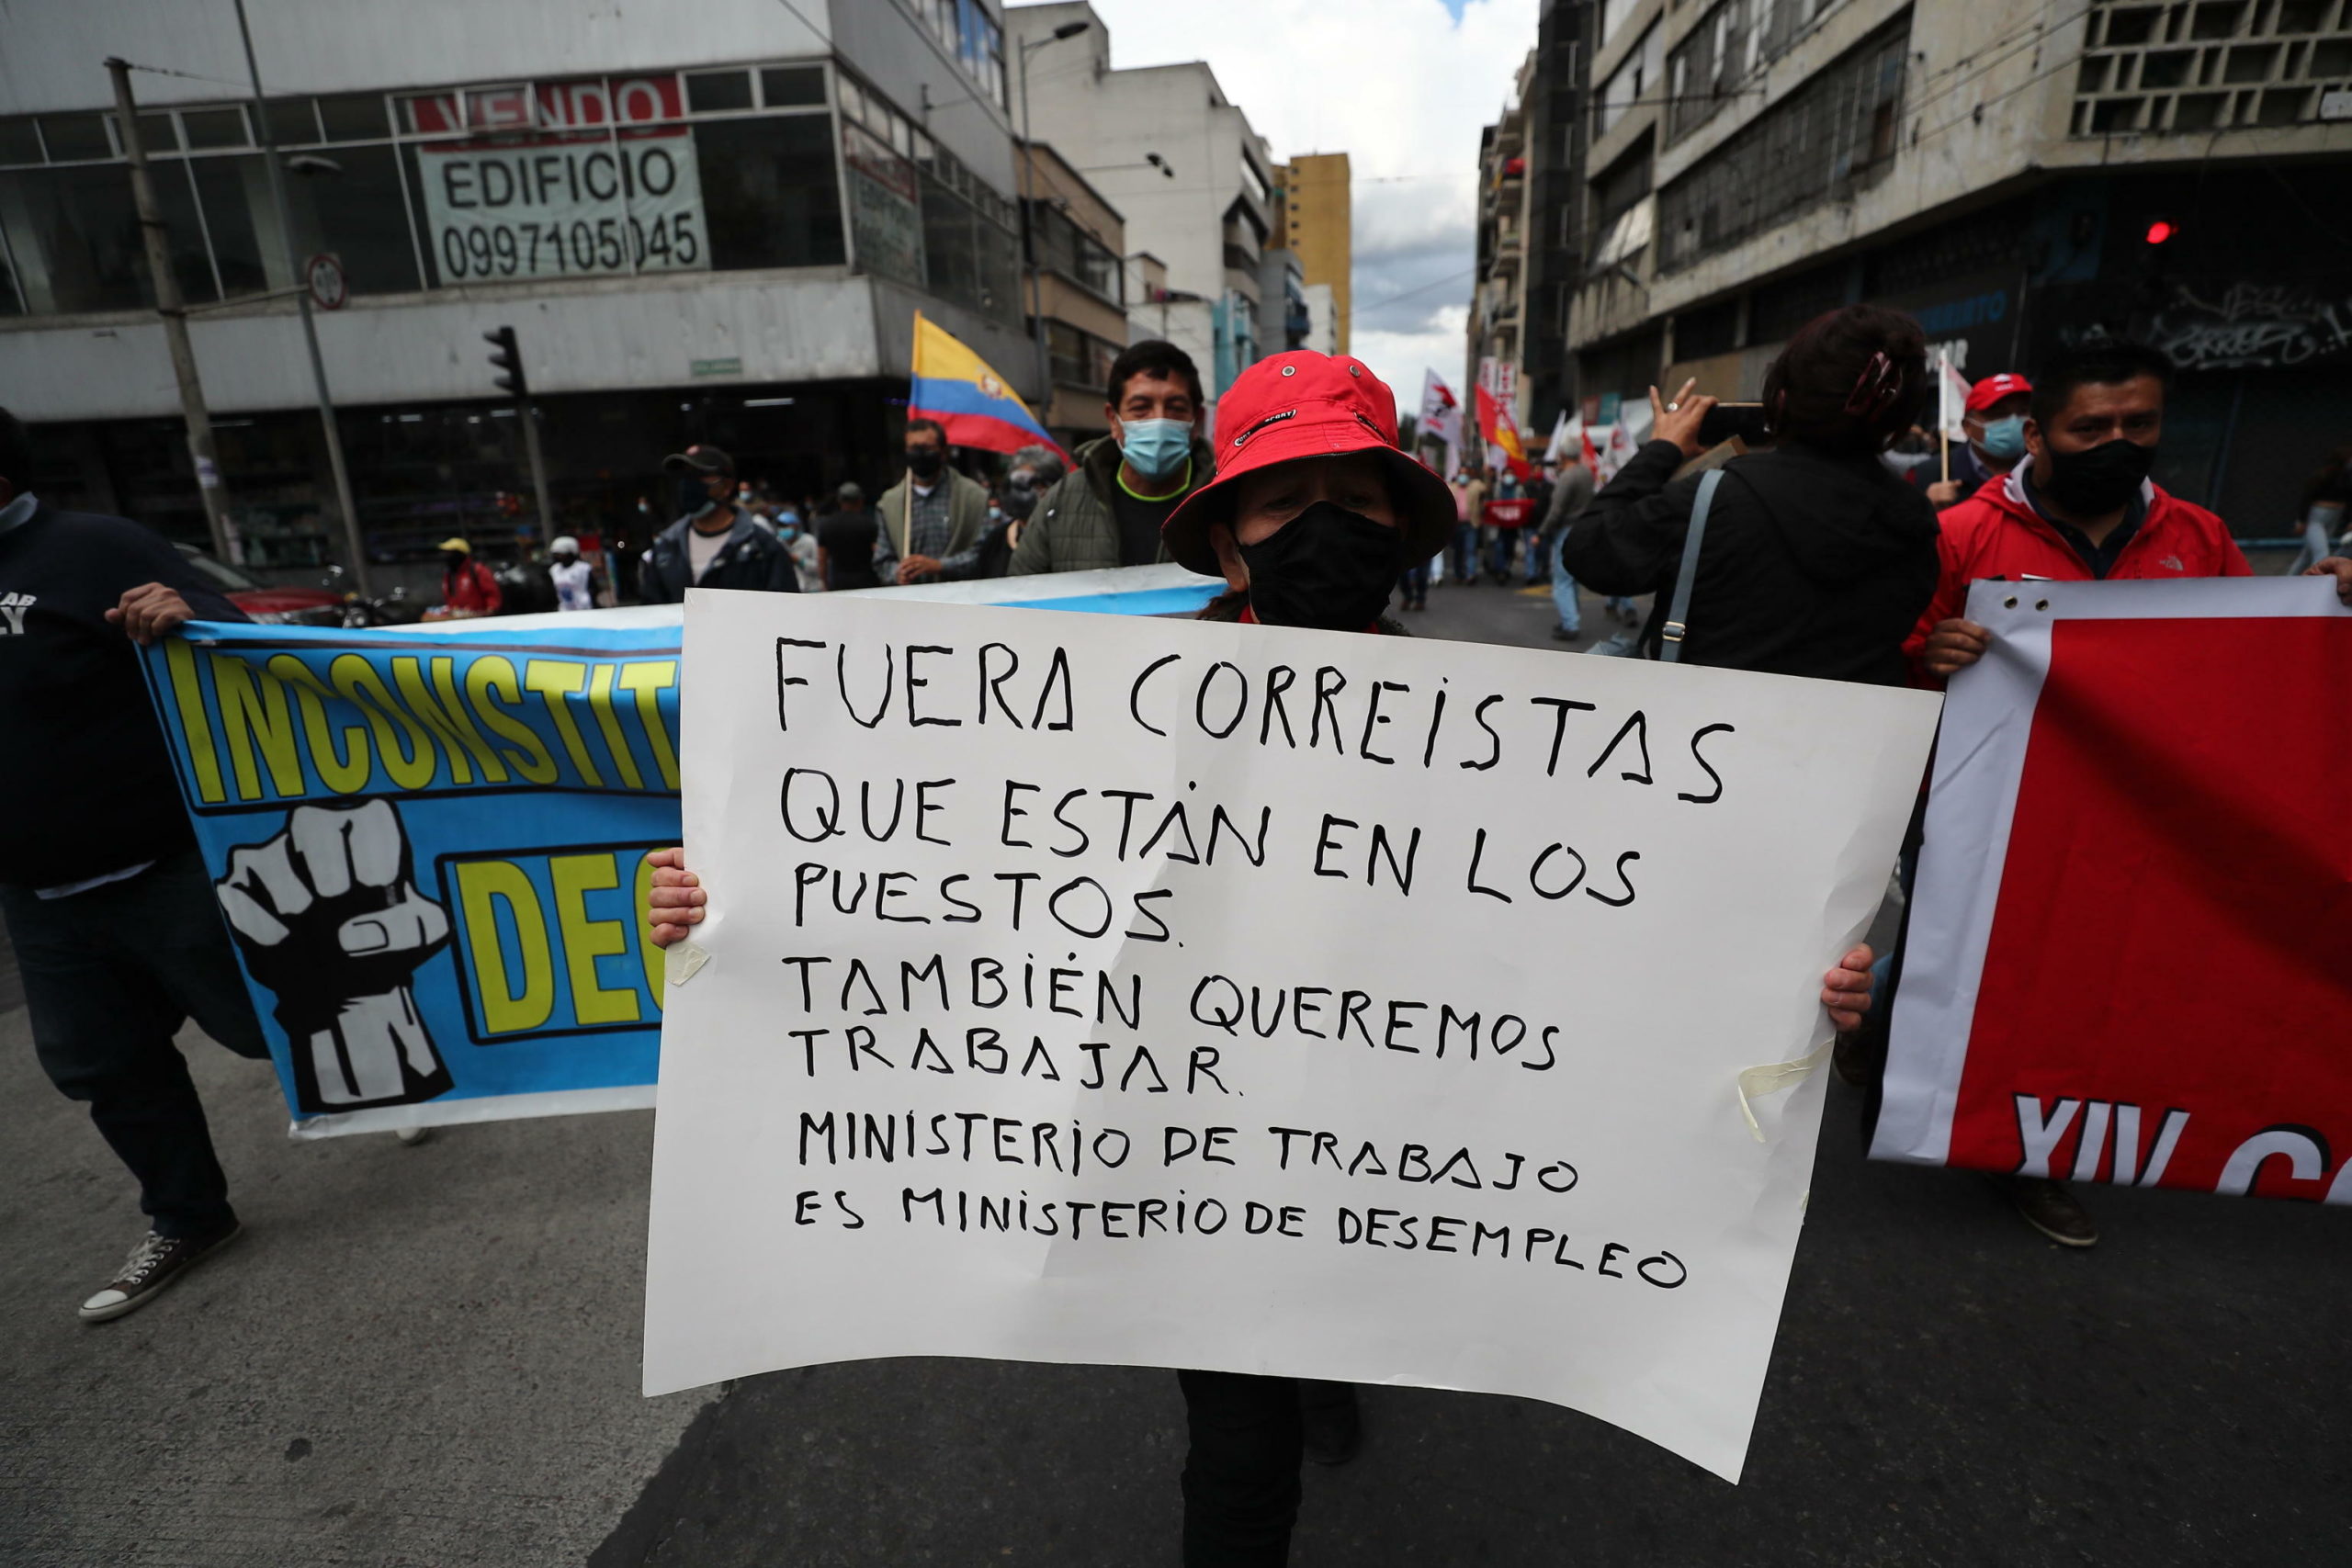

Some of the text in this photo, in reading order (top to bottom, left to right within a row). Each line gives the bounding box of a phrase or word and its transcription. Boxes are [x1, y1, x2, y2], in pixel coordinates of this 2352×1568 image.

[434, 78, 665, 147] VENDO
[442, 148, 676, 209] EDIFICIO
[443, 213, 698, 278] 0997105045
[0, 592, 38, 607] AB
[775, 637, 1736, 804] FUERA CORREISTAS
[780, 767, 1641, 908] QUE ESTÁN EN LOS
[794, 862, 1184, 948] PUESTOS.
[781, 952, 1559, 1071] TAMBIÉN QUEREMOS
[787, 1024, 1245, 1097] TRABAJAR.
[798, 1110, 1578, 1193] MINISTERIO DE TRABAJO
[795, 1187, 1688, 1289] ES MINISTERIO DE DESEMPLEO
